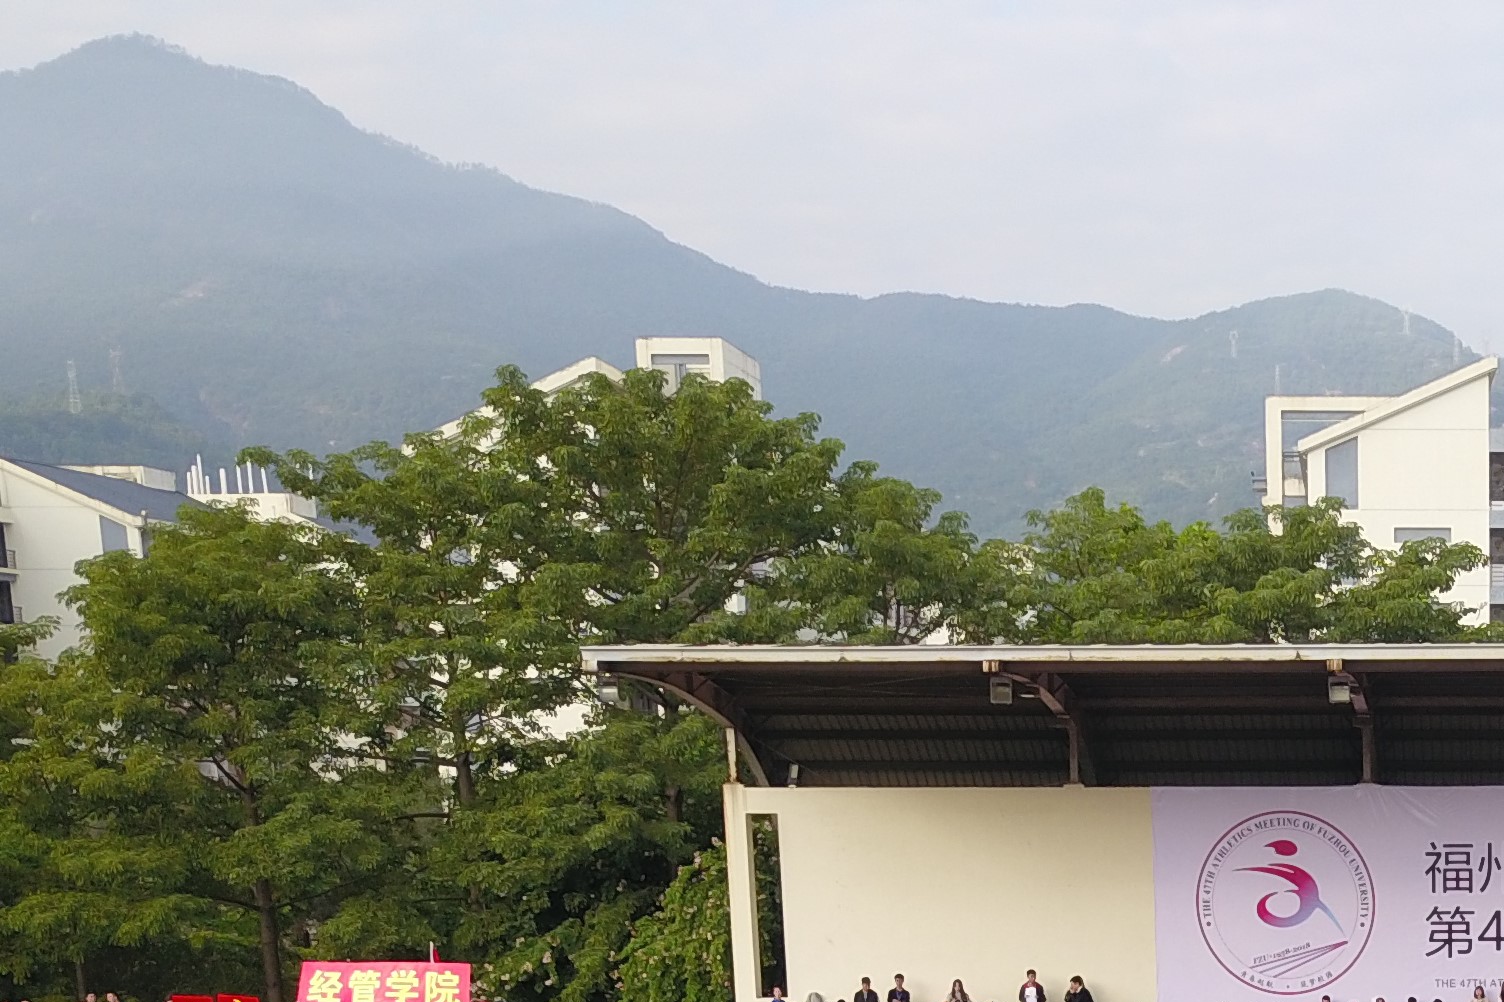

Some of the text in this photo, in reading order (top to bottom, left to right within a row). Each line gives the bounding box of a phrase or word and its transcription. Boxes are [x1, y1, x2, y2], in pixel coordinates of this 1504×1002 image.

[1211, 826, 1254, 869] ATHLETICS
[1254, 817, 1300, 832] MEETING
[1302, 819, 1317, 832] OF
[1317, 825, 1351, 858] FUZHOU
[1349, 857, 1370, 919] UNIVERSITY
[1435, 978, 1457, 988] THE
[1459, 978, 1487, 988] 47TH
